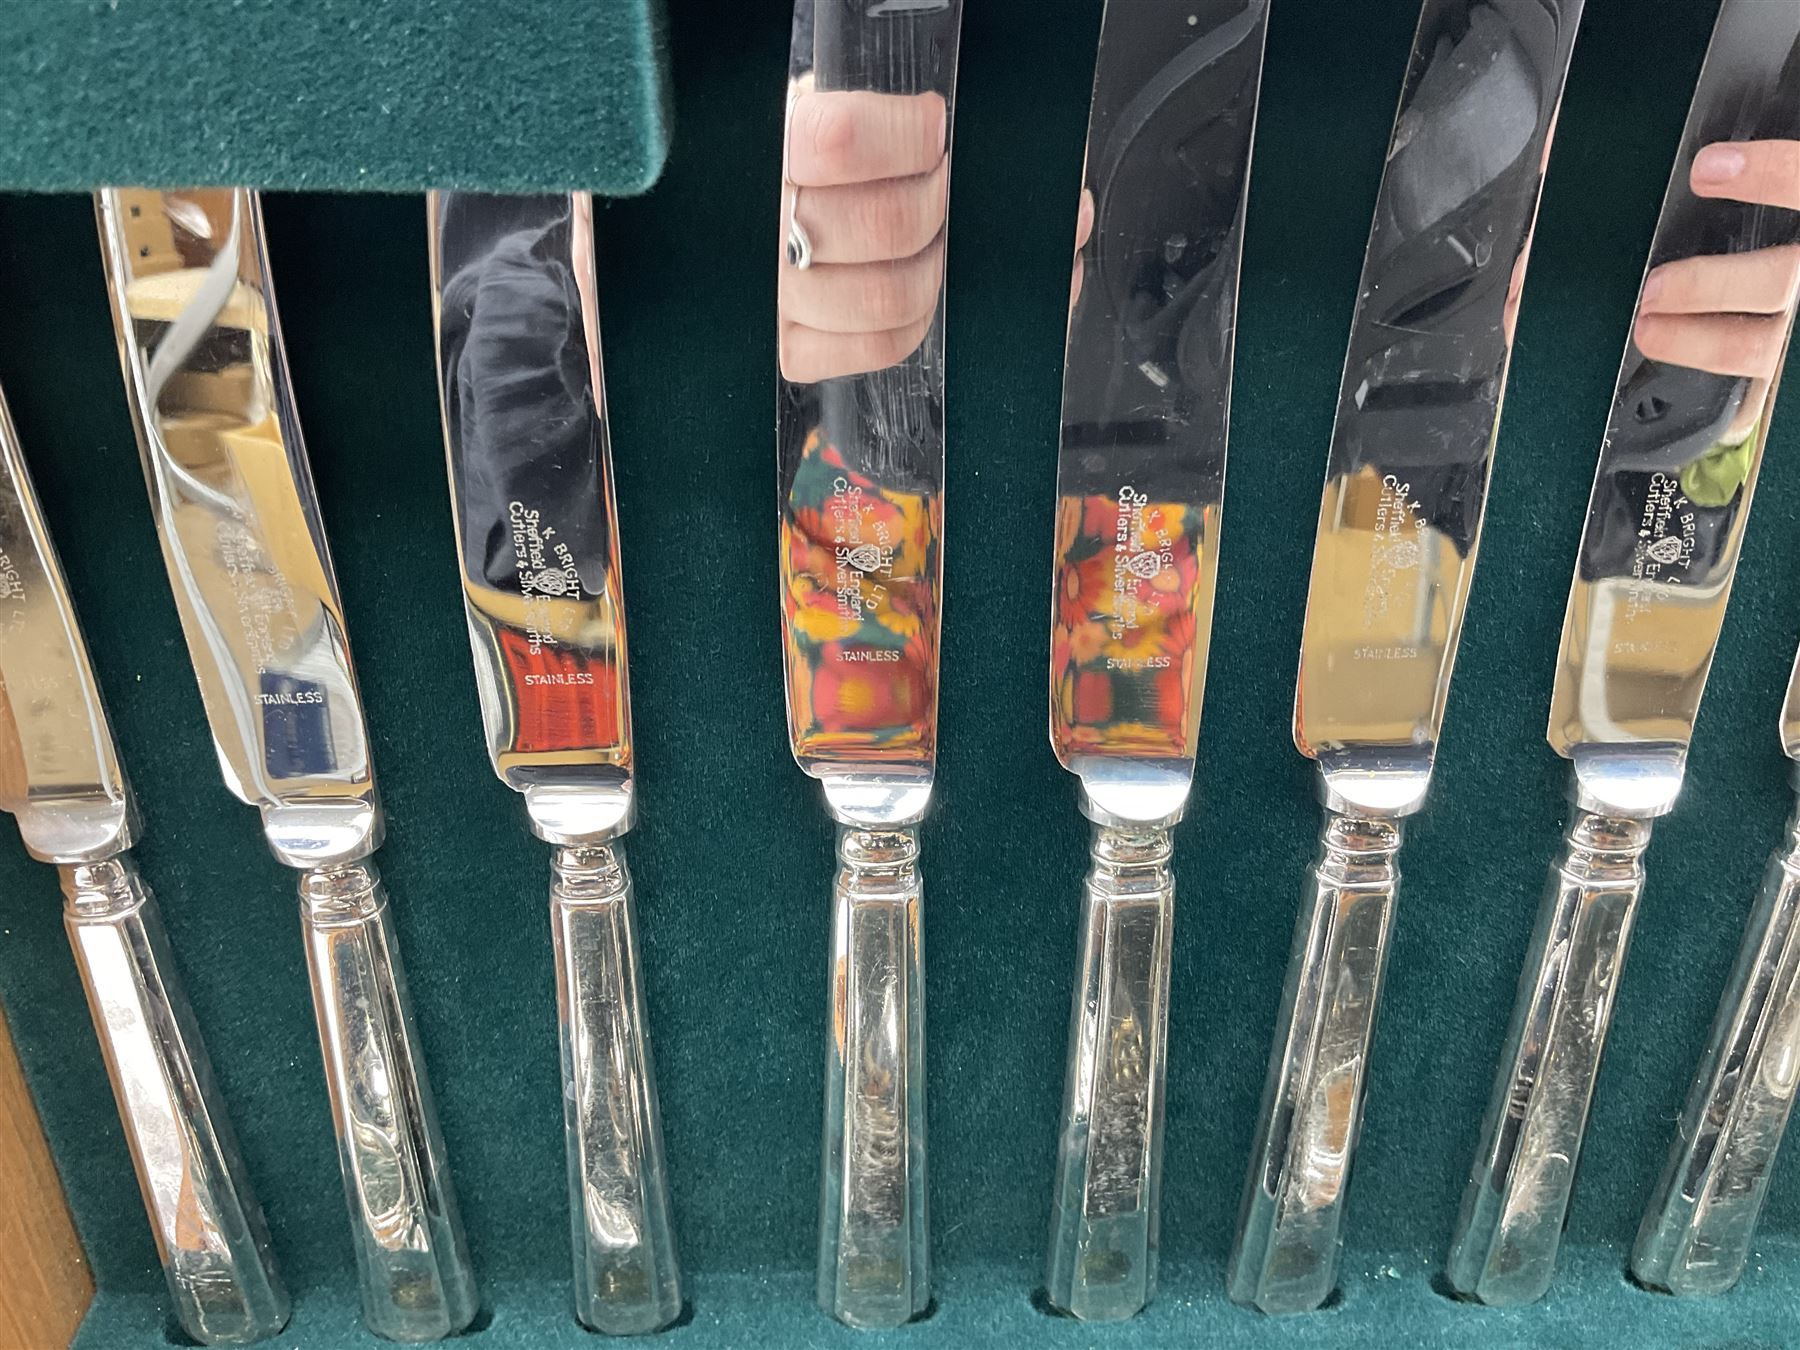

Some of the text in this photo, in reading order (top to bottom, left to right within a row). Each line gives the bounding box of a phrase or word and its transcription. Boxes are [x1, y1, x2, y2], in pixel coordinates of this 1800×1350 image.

[833, 476, 848, 533] Cutlers
[1116, 485, 1135, 547] Cutlers
[1374, 474, 1398, 536] Cutlers
[1641, 472, 1666, 532] Cutlers
[1673, 496, 1689, 510] K
[508, 501, 528, 563] Cutlers
[524, 509, 547, 570] Sheffield
[872, 520, 894, 579] BRIGHT
[1679, 512, 1697, 570] BRIGHT
[553, 542, 581, 601] BRIGHT
[849, 570, 865, 622] England
[865, 584, 888, 611] LTD
[525, 673, 594, 686] STAINLESS
[836, 650, 900, 663] STAINLESS
[254, 691, 323, 706] STAINLESS
